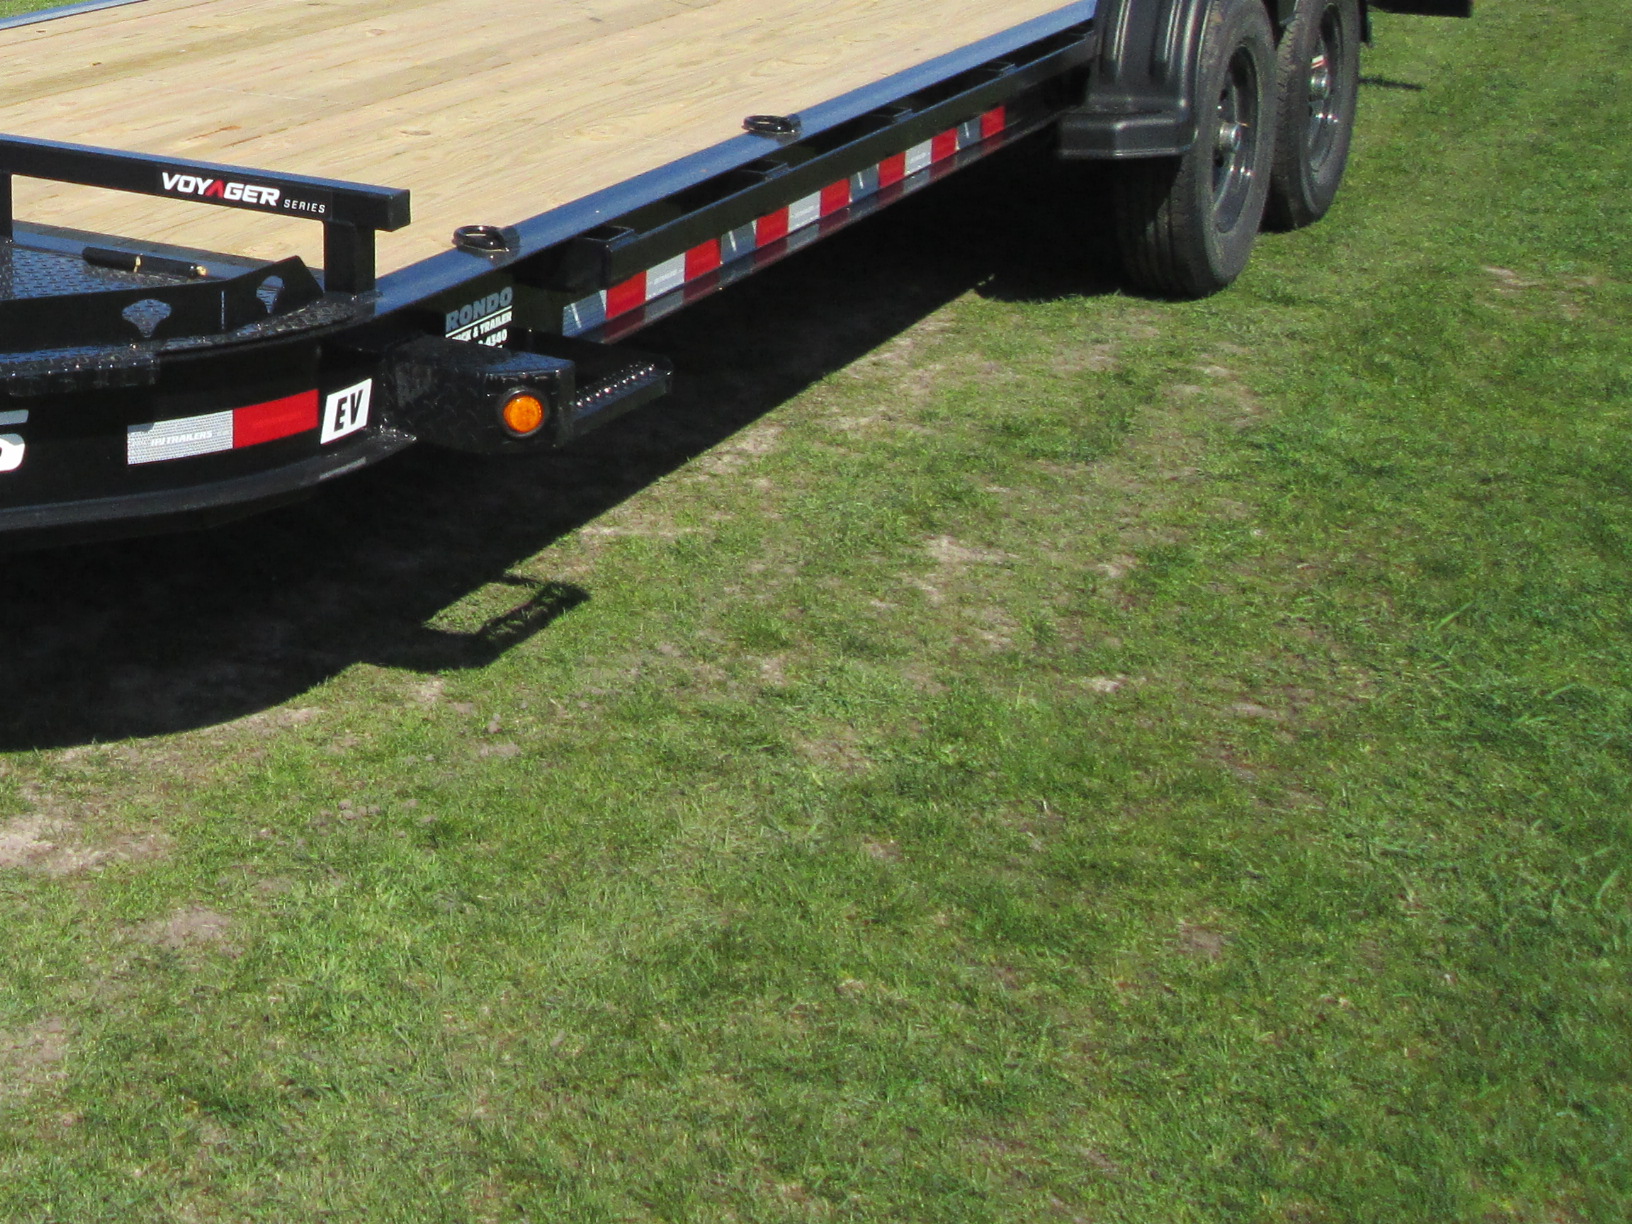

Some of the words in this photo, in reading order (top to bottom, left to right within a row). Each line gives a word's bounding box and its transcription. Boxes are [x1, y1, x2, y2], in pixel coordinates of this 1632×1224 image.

[162, 172, 280, 206] VOYAGER
[283, 199, 325, 213] SERIES
[446, 286, 513, 332] RONDO
[480, 311, 512, 334] TRAILER
[334, 389, 364, 432] EV
